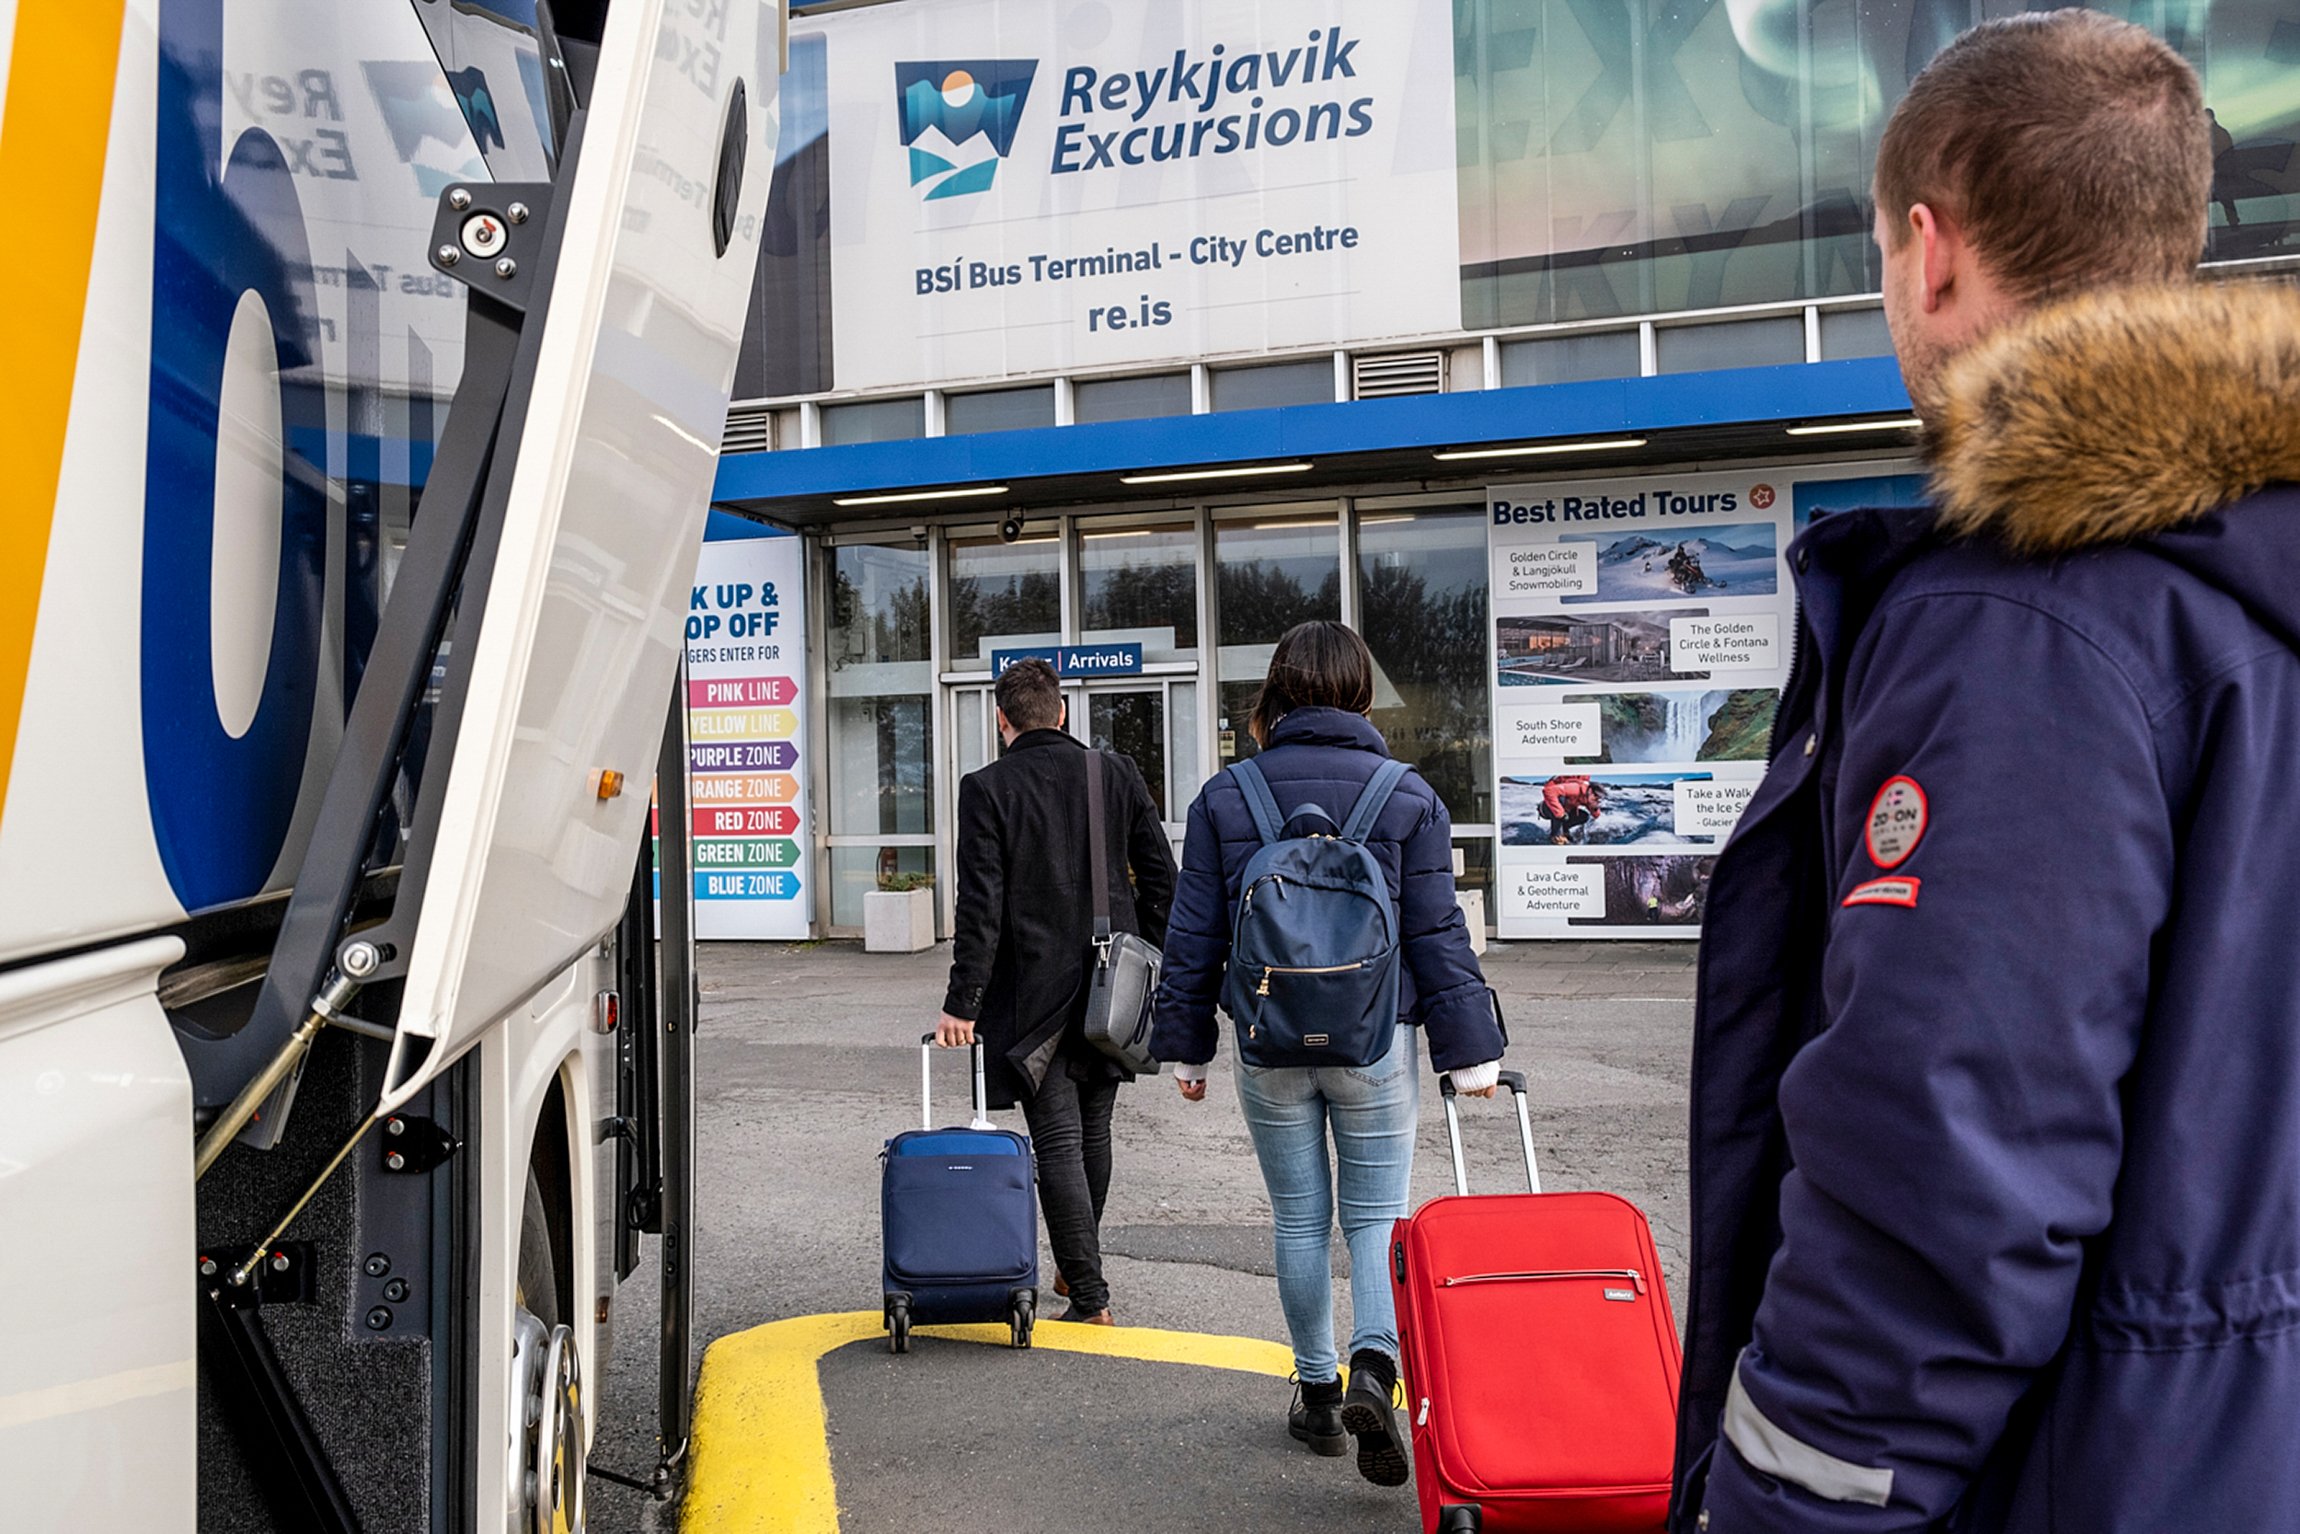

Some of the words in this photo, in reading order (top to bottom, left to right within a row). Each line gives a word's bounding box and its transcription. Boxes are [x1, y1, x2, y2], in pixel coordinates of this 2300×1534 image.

[1060, 27, 1359, 122] Reykjavik
[1051, 97, 1373, 174] Excursions
[916, 256, 963, 295] BSÍ
[970, 262, 1021, 288] Bus
[1028, 243, 1161, 282] Terminal
[1190, 236, 1247, 267] City
[1256, 225, 1359, 257] Centre
[1089, 295, 1172, 332] re.is
[1493, 501, 1556, 525] Best
[1563, 493, 1646, 521] Rated
[1653, 491, 1737, 515] Tours
[1510, 552, 1546, 563] Golden
[1548, 550, 1578, 561] Circle
[1512, 566, 1520, 577] &
[1523, 563, 1576, 577] Langjökull
[1509, 579, 1582, 591] Snowmobiling
[717, 583, 753, 609] UP
[761, 581, 778, 607] &
[729, 611, 779, 638] OFF
[1690, 624, 1711, 635] The
[1714, 623, 1754, 634] Golden
[1679, 639, 1710, 649] Circle
[1713, 638, 1721, 648] &
[1724, 637, 1769, 648] Fontana
[720, 646, 754, 662] ENTER
[759, 645, 779, 660] FOR
[1069, 651, 1134, 669] Arrivals
[1698, 652, 1750, 663] Wellness
[707, 682, 744, 702] PINK
[748, 681, 780, 701] LINE
[691, 715, 747, 735] YELLOW
[751, 713, 781, 733] LINE
[1516, 720, 1547, 731] South
[1550, 719, 1582, 730] Shore
[1522, 734, 1577, 744] Adventure
[746, 746, 781, 766] ZONE
[692, 779, 743, 799] RANGE
[747, 778, 782, 798] ZONE
[1686, 788, 1713, 799] Take
[1715, 790, 1722, 799] a
[1724, 788, 1752, 798] Walk
[1697, 803, 1714, 813] the
[1717, 803, 1732, 813] Ice
[715, 811, 743, 831] RED
[747, 810, 783, 830] ZONE
[1702, 817, 1733, 827] Glacier
[697, 843, 744, 863] GREEN
[748, 843, 783, 862] ZONE
[708, 876, 745, 895] BLUE
[748, 875, 784, 895] ZONE
[1526, 872, 1551, 882] Lava
[1553, 871, 1579, 882] Cave
[1518, 886, 1525, 896] &
[1527, 885, 1589, 896] Geothermal
[1526, 900, 1581, 910] Adventure
